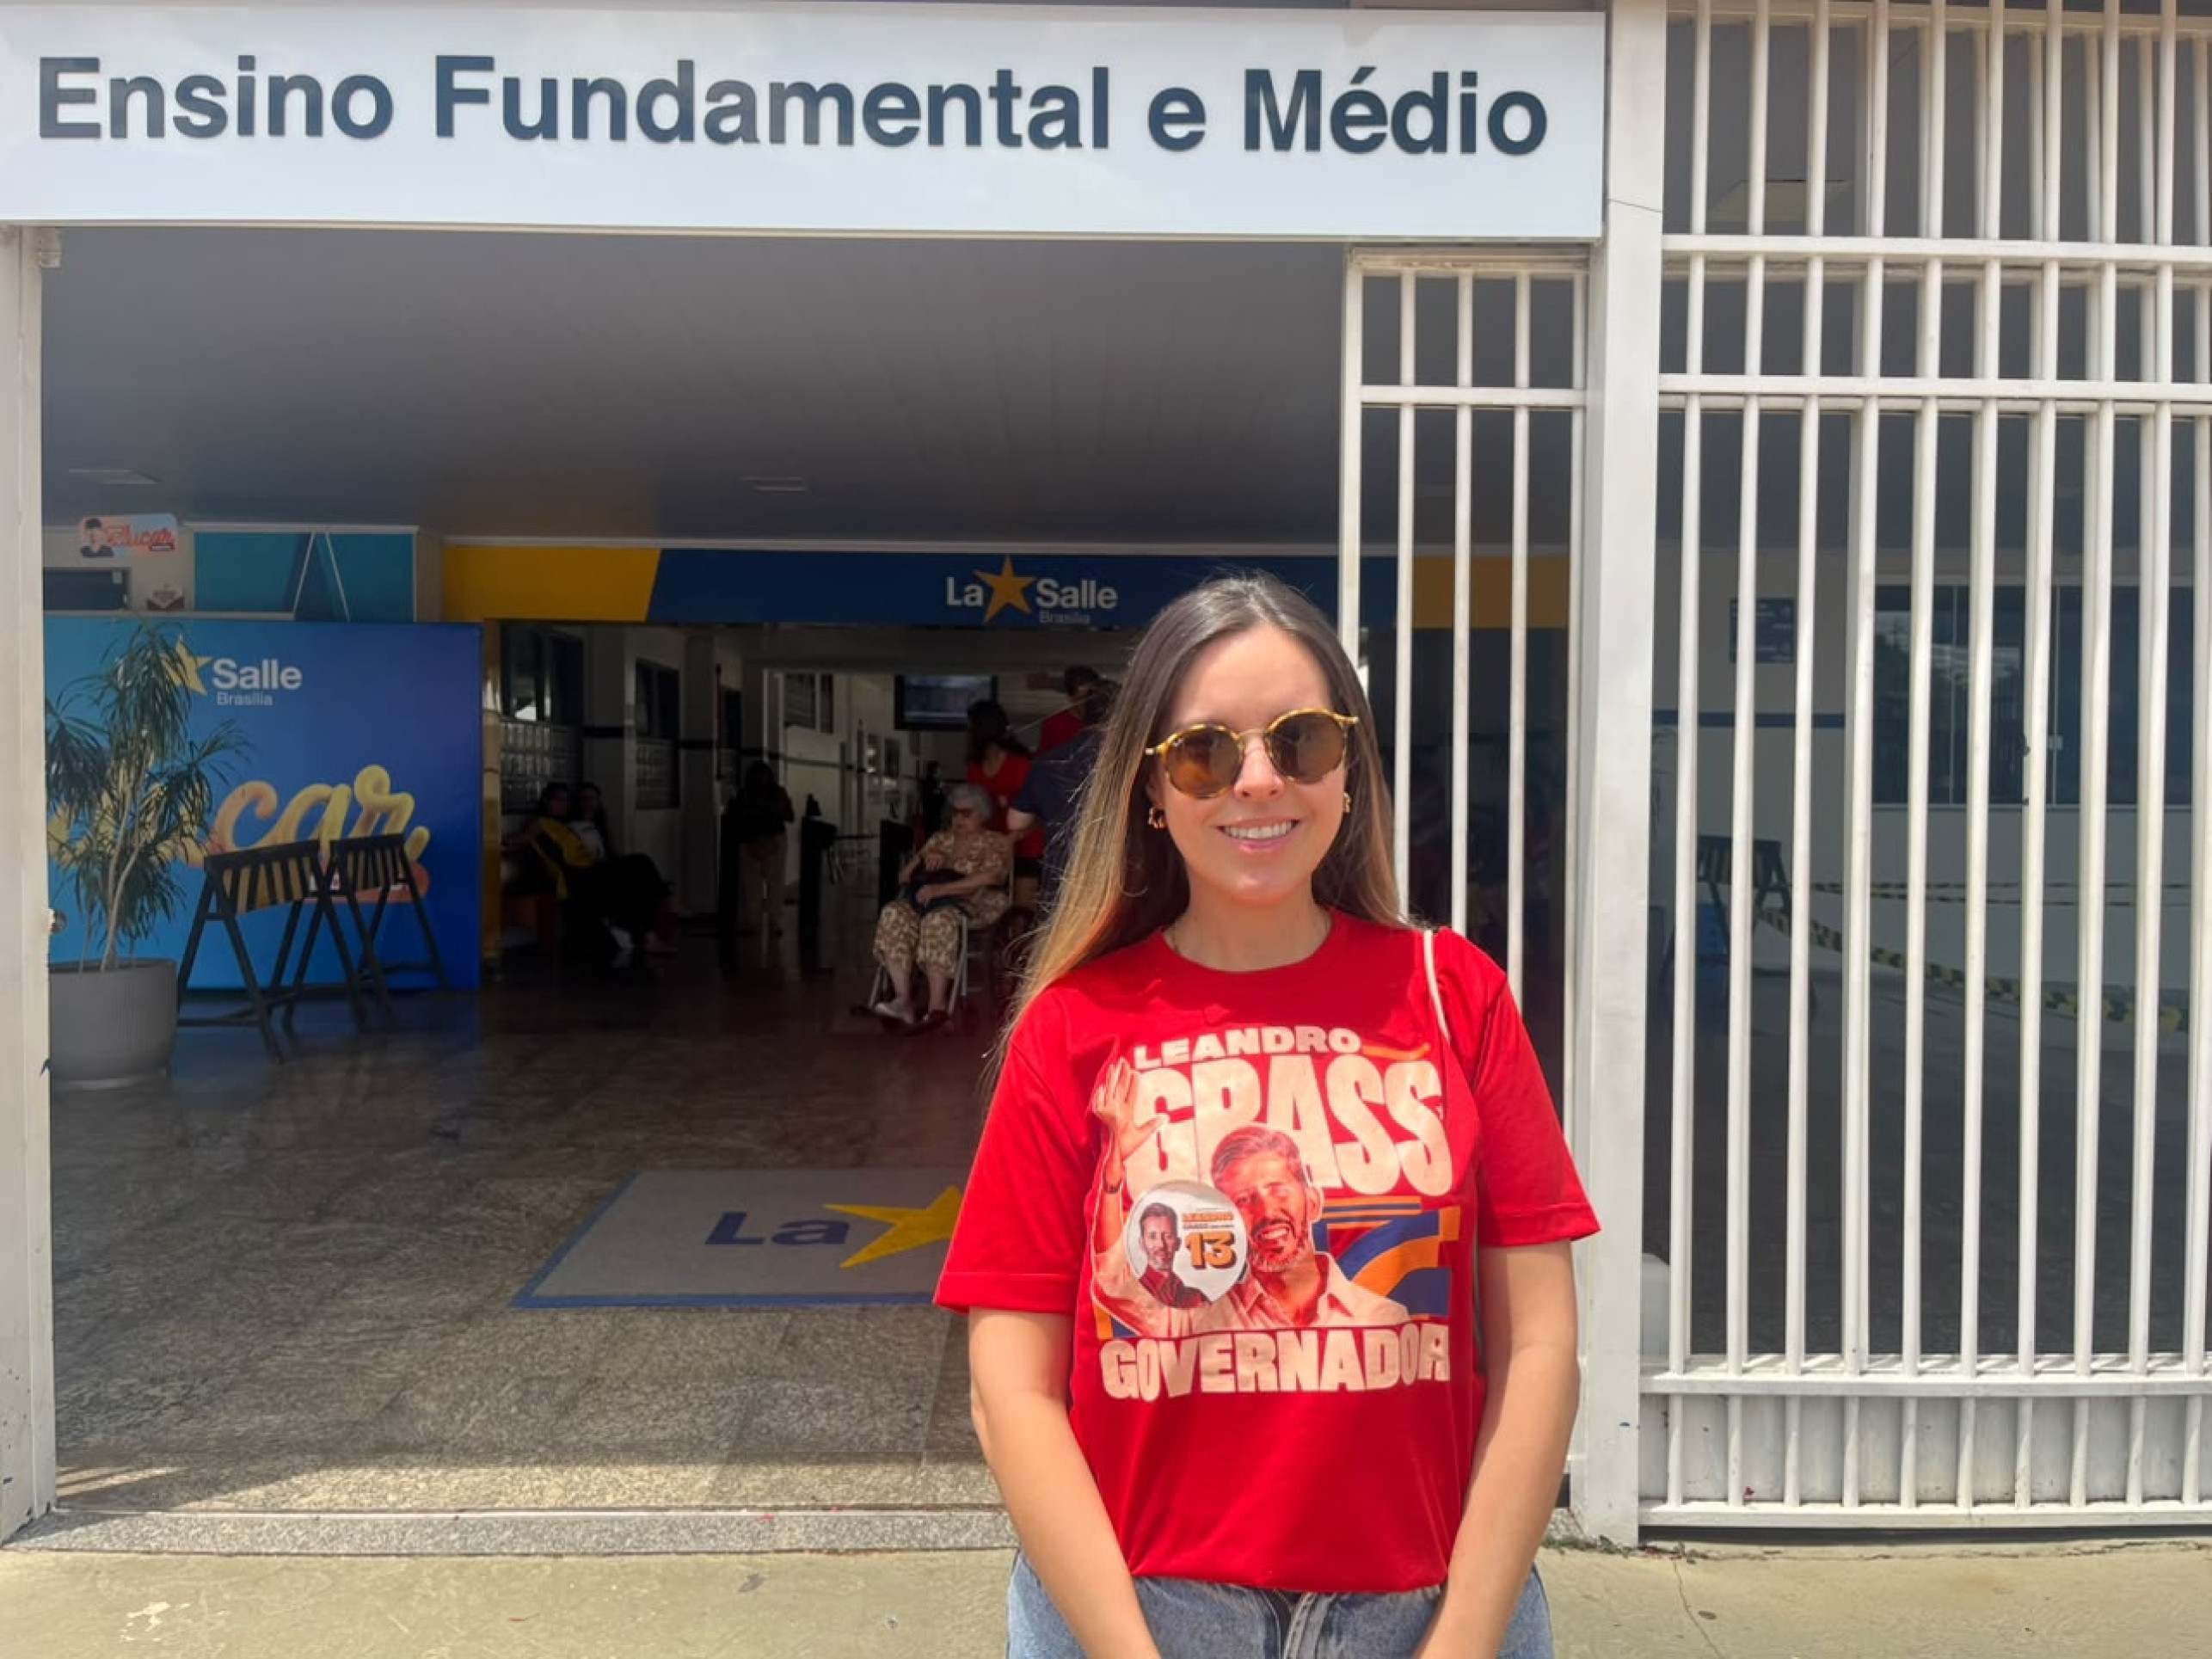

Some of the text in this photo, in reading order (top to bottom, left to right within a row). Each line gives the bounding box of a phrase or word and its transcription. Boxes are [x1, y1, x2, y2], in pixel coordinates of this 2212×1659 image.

[39, 54, 1548, 157] Ensino Fundamental e Médio
[946, 576, 1117, 609] La Salle
[212, 658, 303, 691] Salle
[1134, 1026, 1361, 1068] LEANDRO
[1125, 1054, 1453, 1205] GRASS
[704, 1212, 851, 1245] La
[1184, 1231, 1237, 1269] 13
[1100, 1323, 1450, 1401] GOVERNADOR
